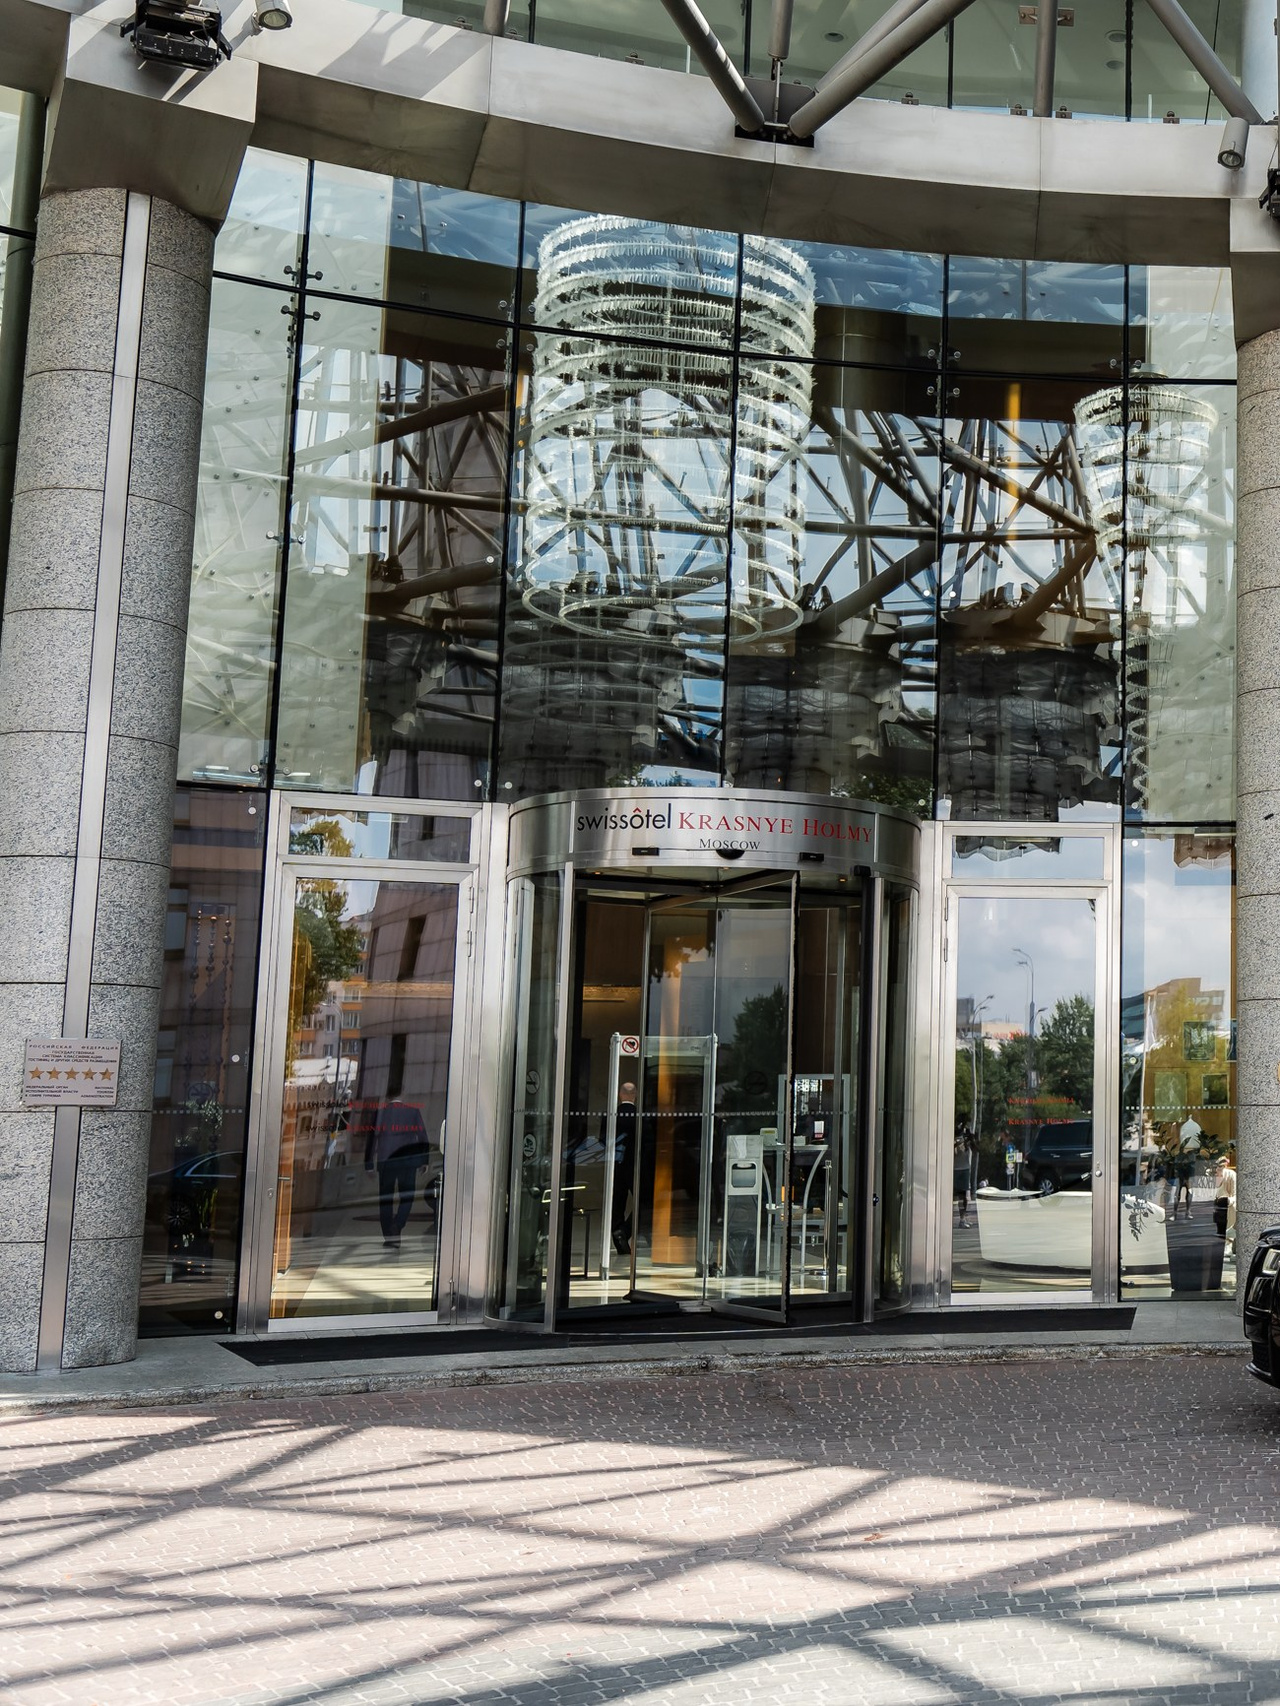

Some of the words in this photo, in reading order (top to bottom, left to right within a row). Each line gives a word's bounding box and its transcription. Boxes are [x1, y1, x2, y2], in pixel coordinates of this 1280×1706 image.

[577, 803, 671, 832] swissôtel
[678, 811, 793, 835] KRASNYE
[803, 819, 873, 843] HOLMY
[699, 838, 761, 850] MOSCOW
